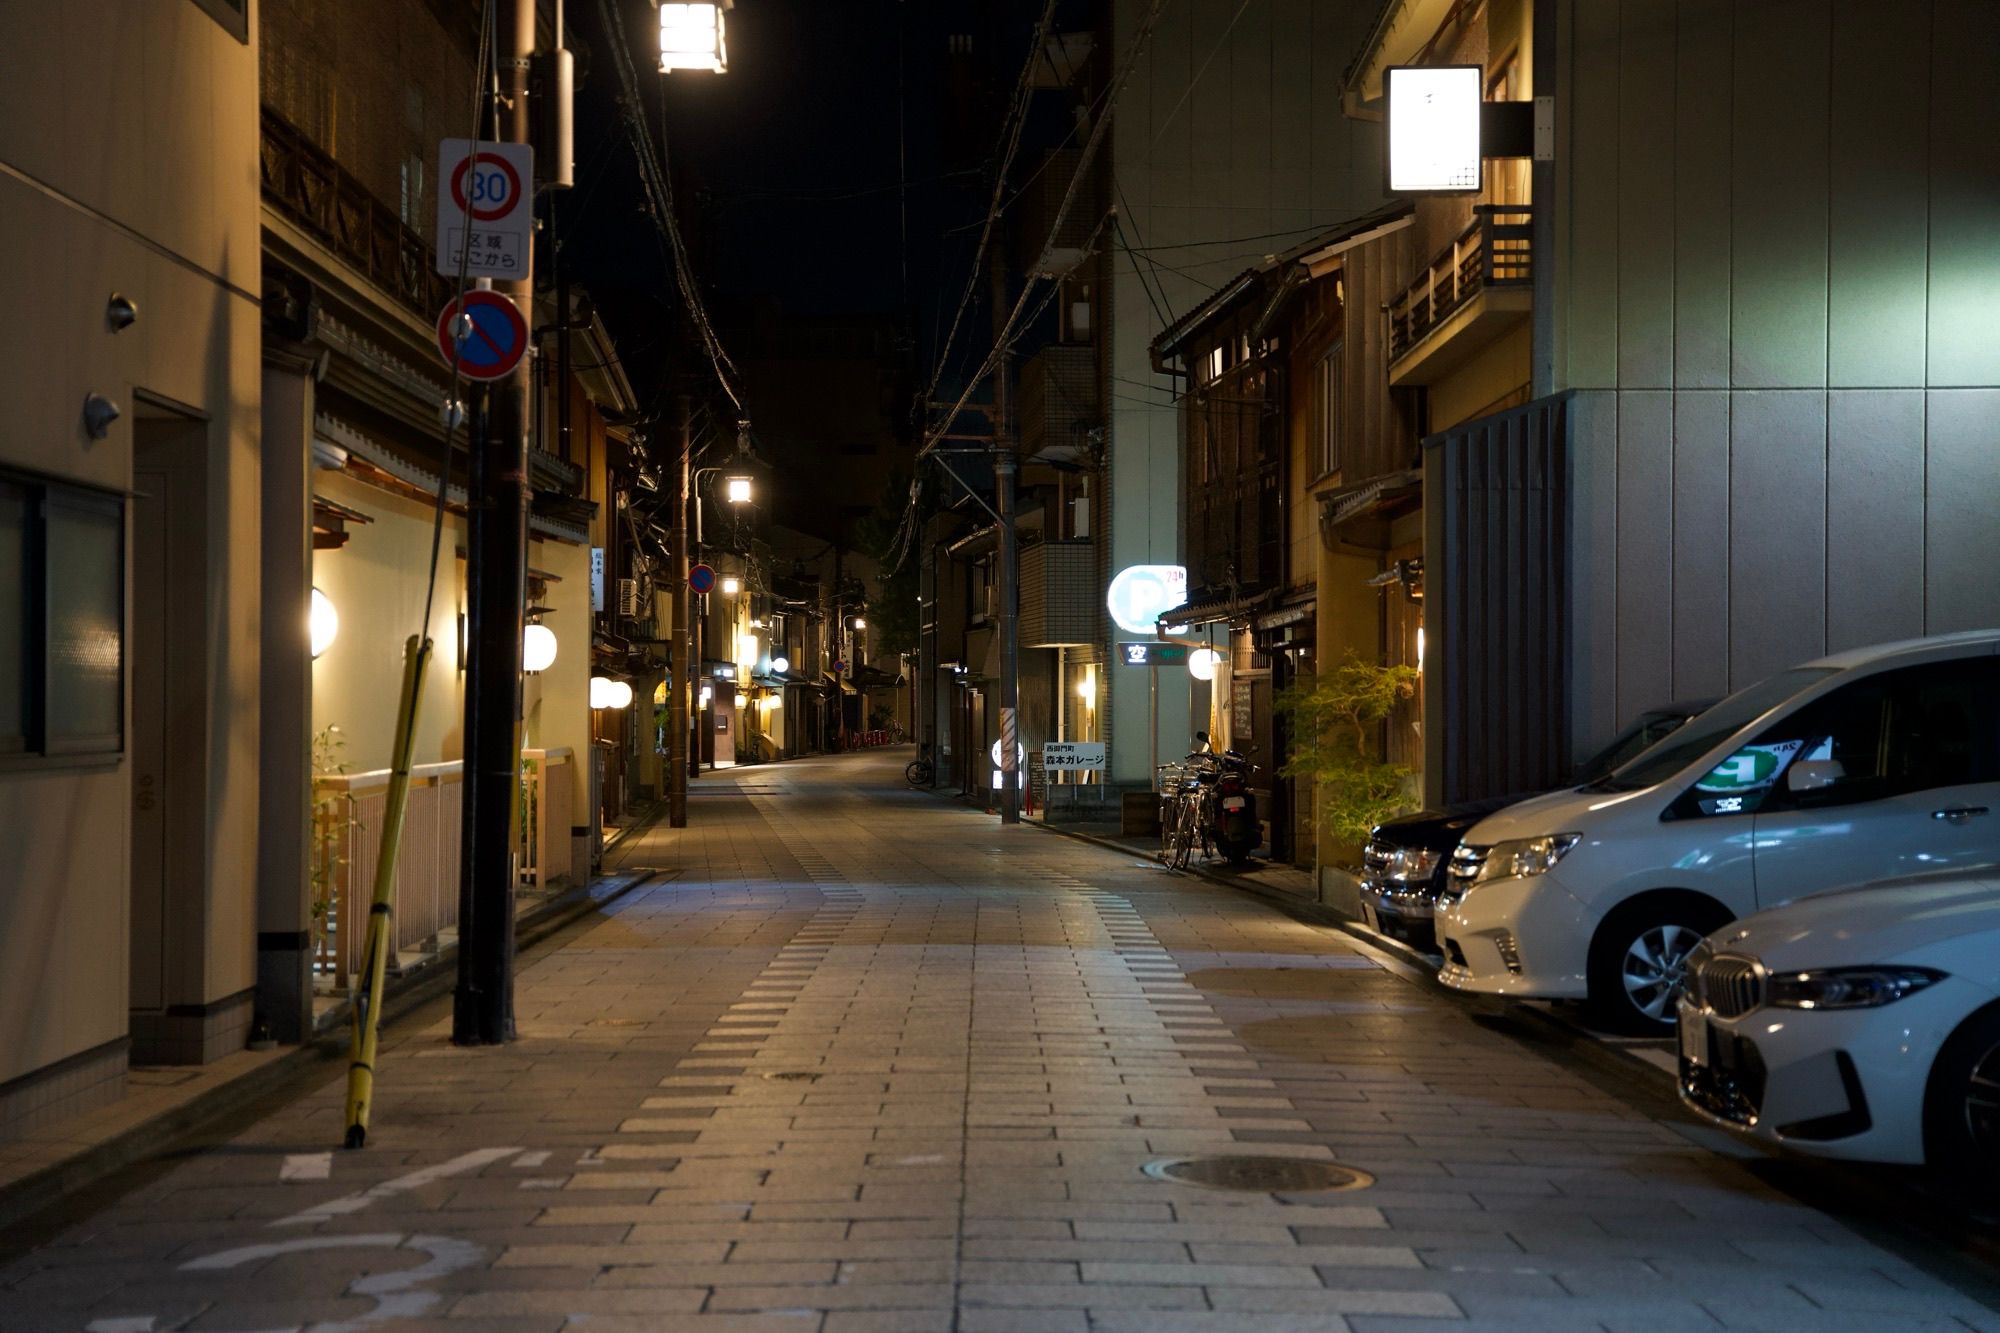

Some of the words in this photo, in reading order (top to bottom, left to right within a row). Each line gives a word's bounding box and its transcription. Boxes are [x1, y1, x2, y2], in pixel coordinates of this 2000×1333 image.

[471, 172, 506, 203] 30
[469, 233, 502, 249] 区域
[452, 249, 515, 268] ここから
[1129, 579, 1163, 622] P
[1128, 644, 1146, 663] 空
[1045, 755, 1104, 765] 森本ガレージ
